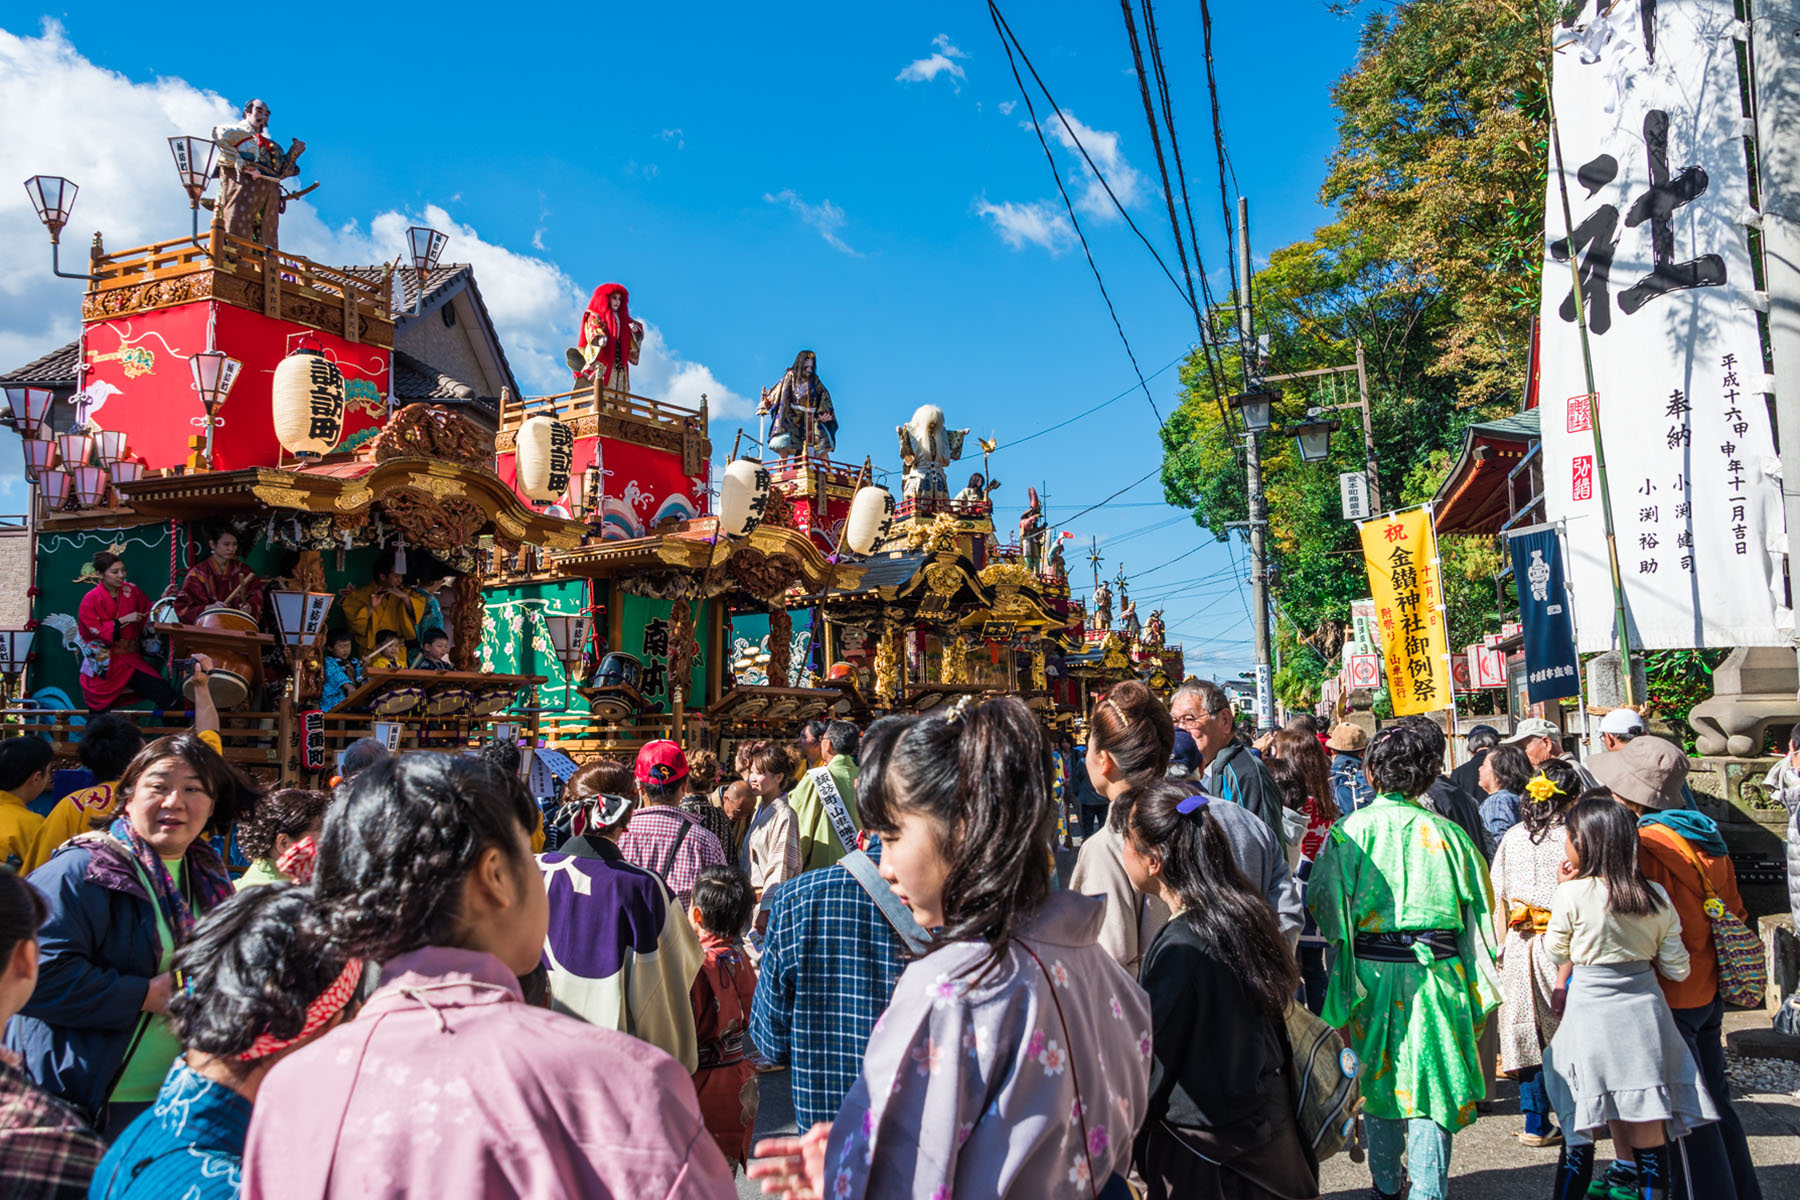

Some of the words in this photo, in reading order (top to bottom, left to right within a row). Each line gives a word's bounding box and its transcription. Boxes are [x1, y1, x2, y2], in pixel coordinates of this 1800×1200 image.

[1550, 0, 1728, 336] 社
[309, 358, 346, 447] 諏訪町
[1665, 388, 1693, 450] 奉納
[547, 421, 573, 497] 諏訪町
[741, 468, 771, 534] 南本町
[1383, 523, 1408, 543] 祝
[306, 597, 324, 633] 諏訪町
[573, 619, 585, 648] 諏訪町
[641, 617, 669, 711] 南本
